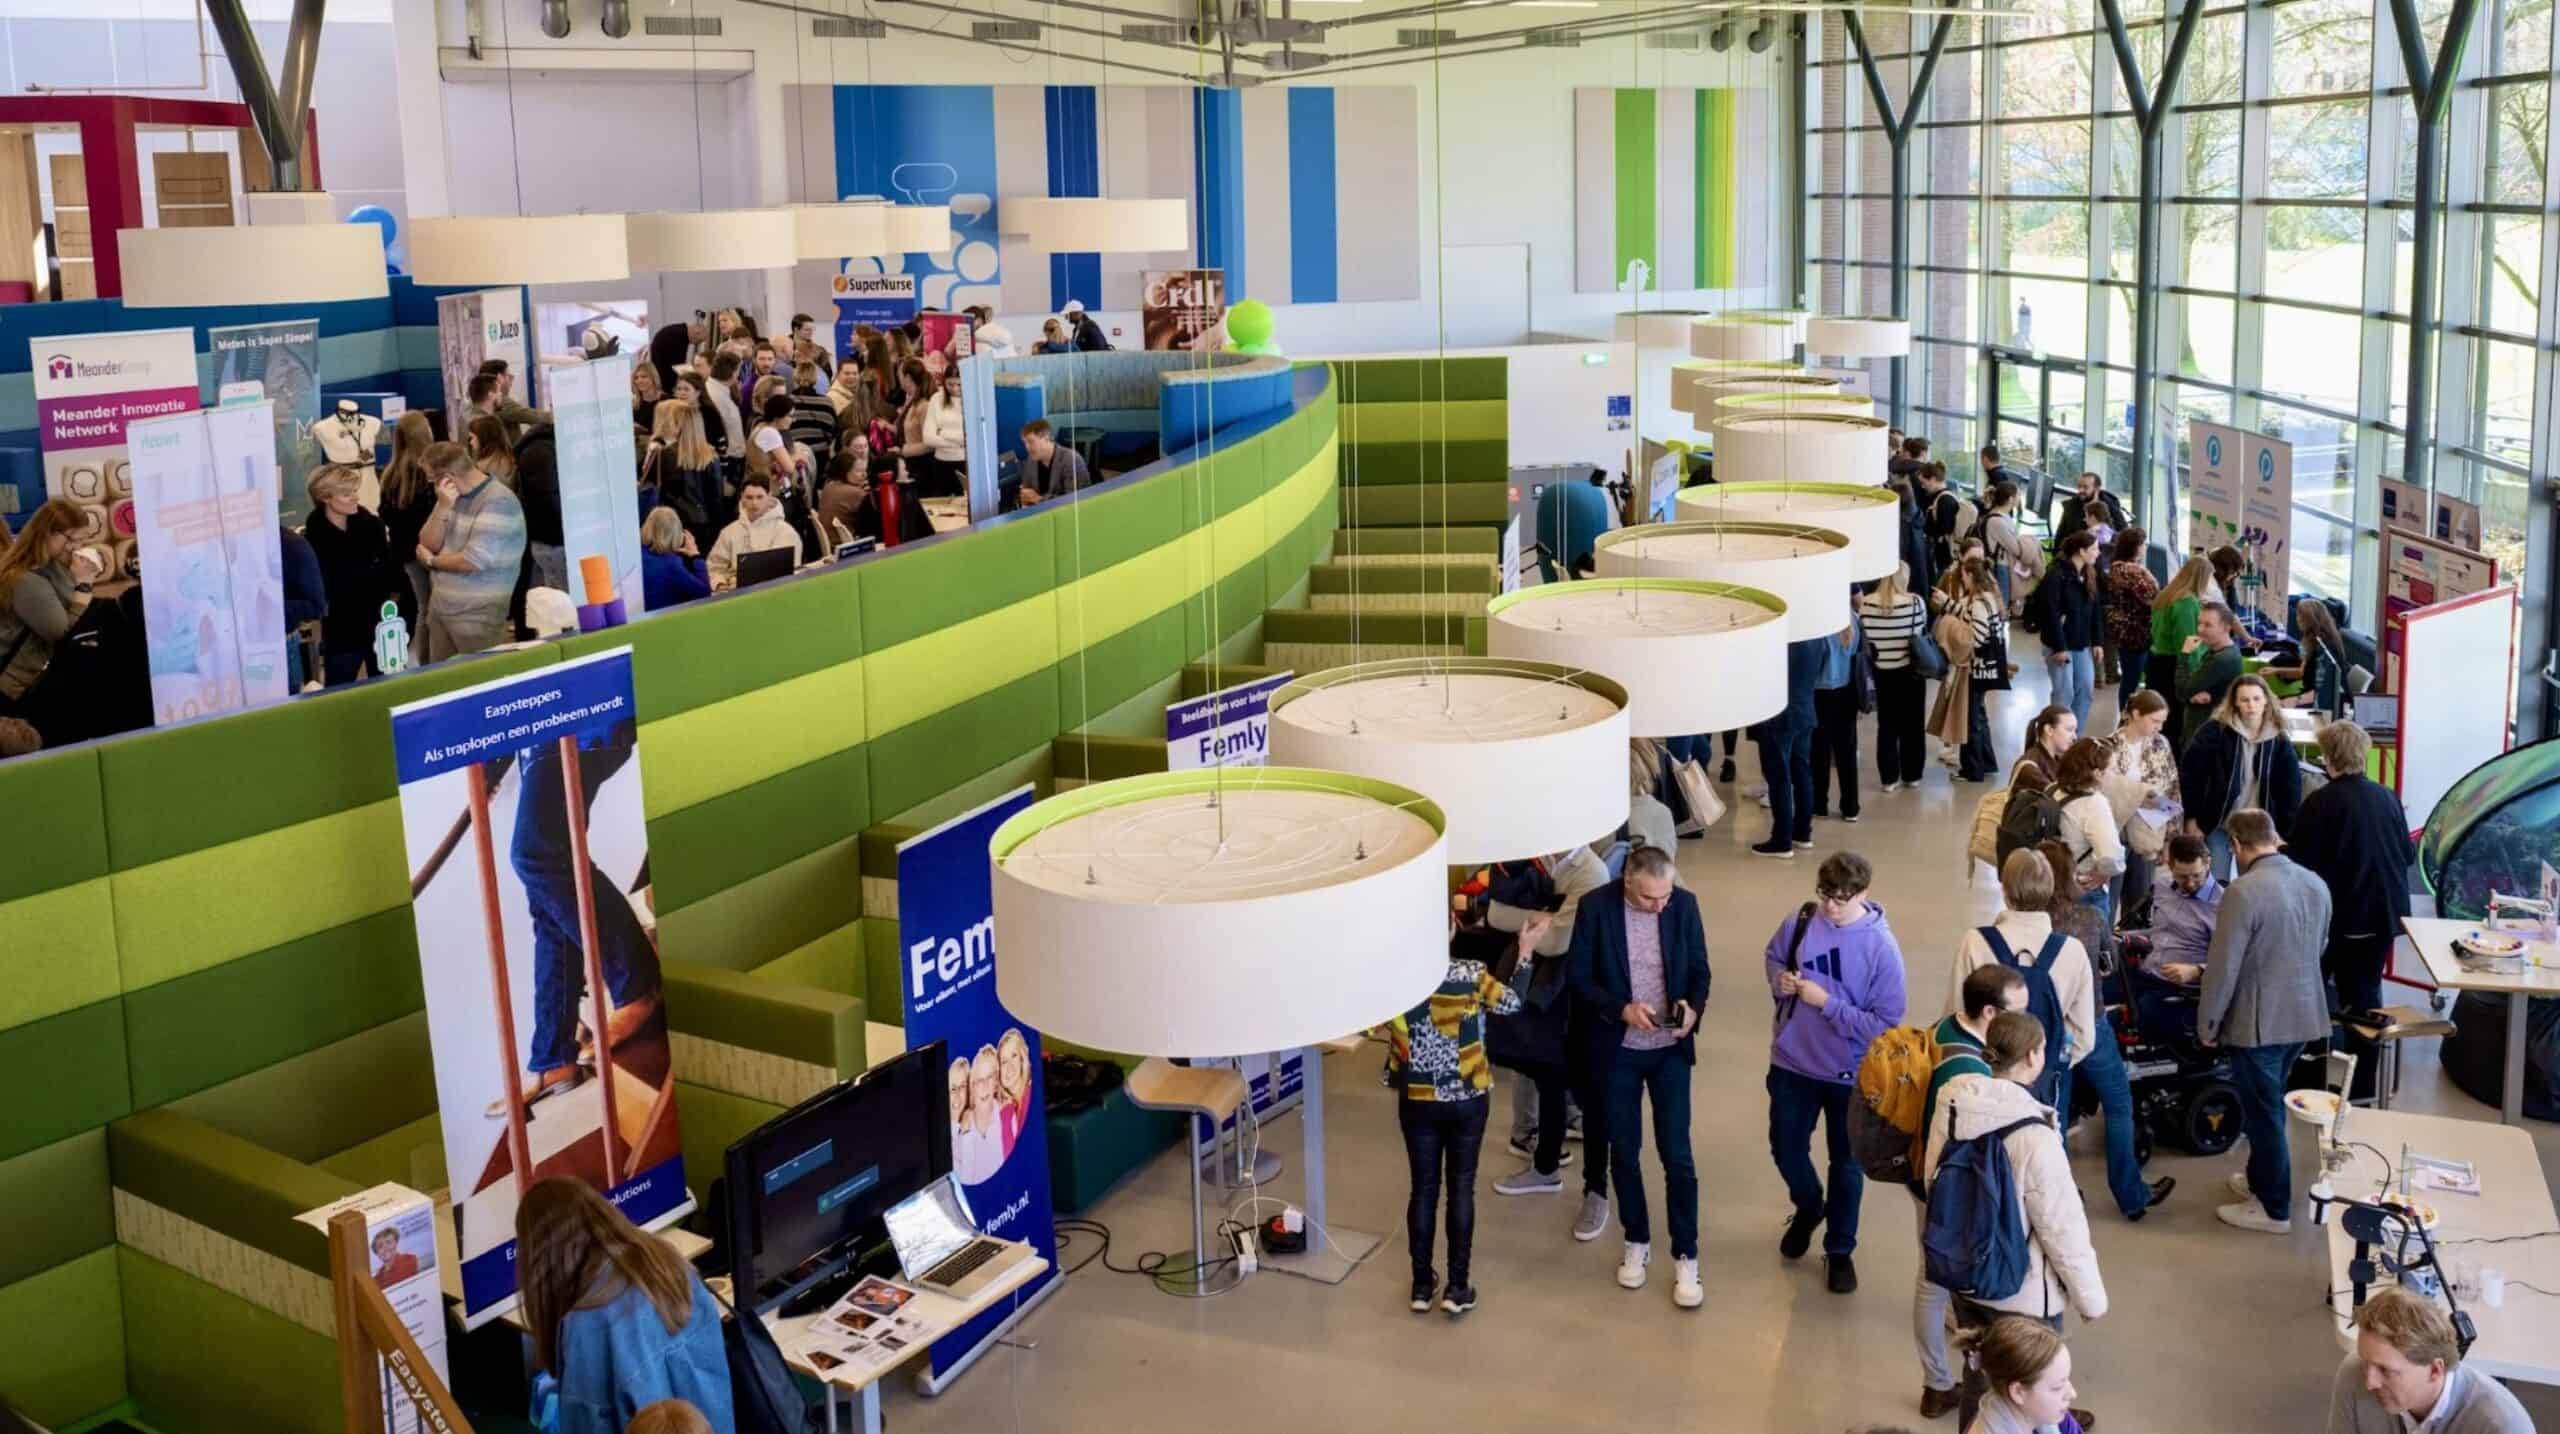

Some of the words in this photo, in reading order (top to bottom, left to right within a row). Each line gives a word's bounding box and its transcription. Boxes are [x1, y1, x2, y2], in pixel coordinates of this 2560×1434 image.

[849, 277, 913, 294] SuperNurse
[498, 320, 520, 341] Juzo
[52, 404, 119, 423] Meander
[121, 399, 187, 416] Innovatie
[54, 423, 119, 440] Netwerk
[484, 688, 563, 719] Easysteppers
[1230, 695, 1249, 710] voor
[423, 747, 445, 764] Als
[445, 730, 507, 757] traplopen
[507, 723, 531, 740] een
[531, 707, 589, 735] probleem
[589, 695, 624, 715] wordt
[1199, 719, 1267, 764] Femly
[910, 914, 995, 999] Fem
[608, 1177, 652, 1209] olutions
